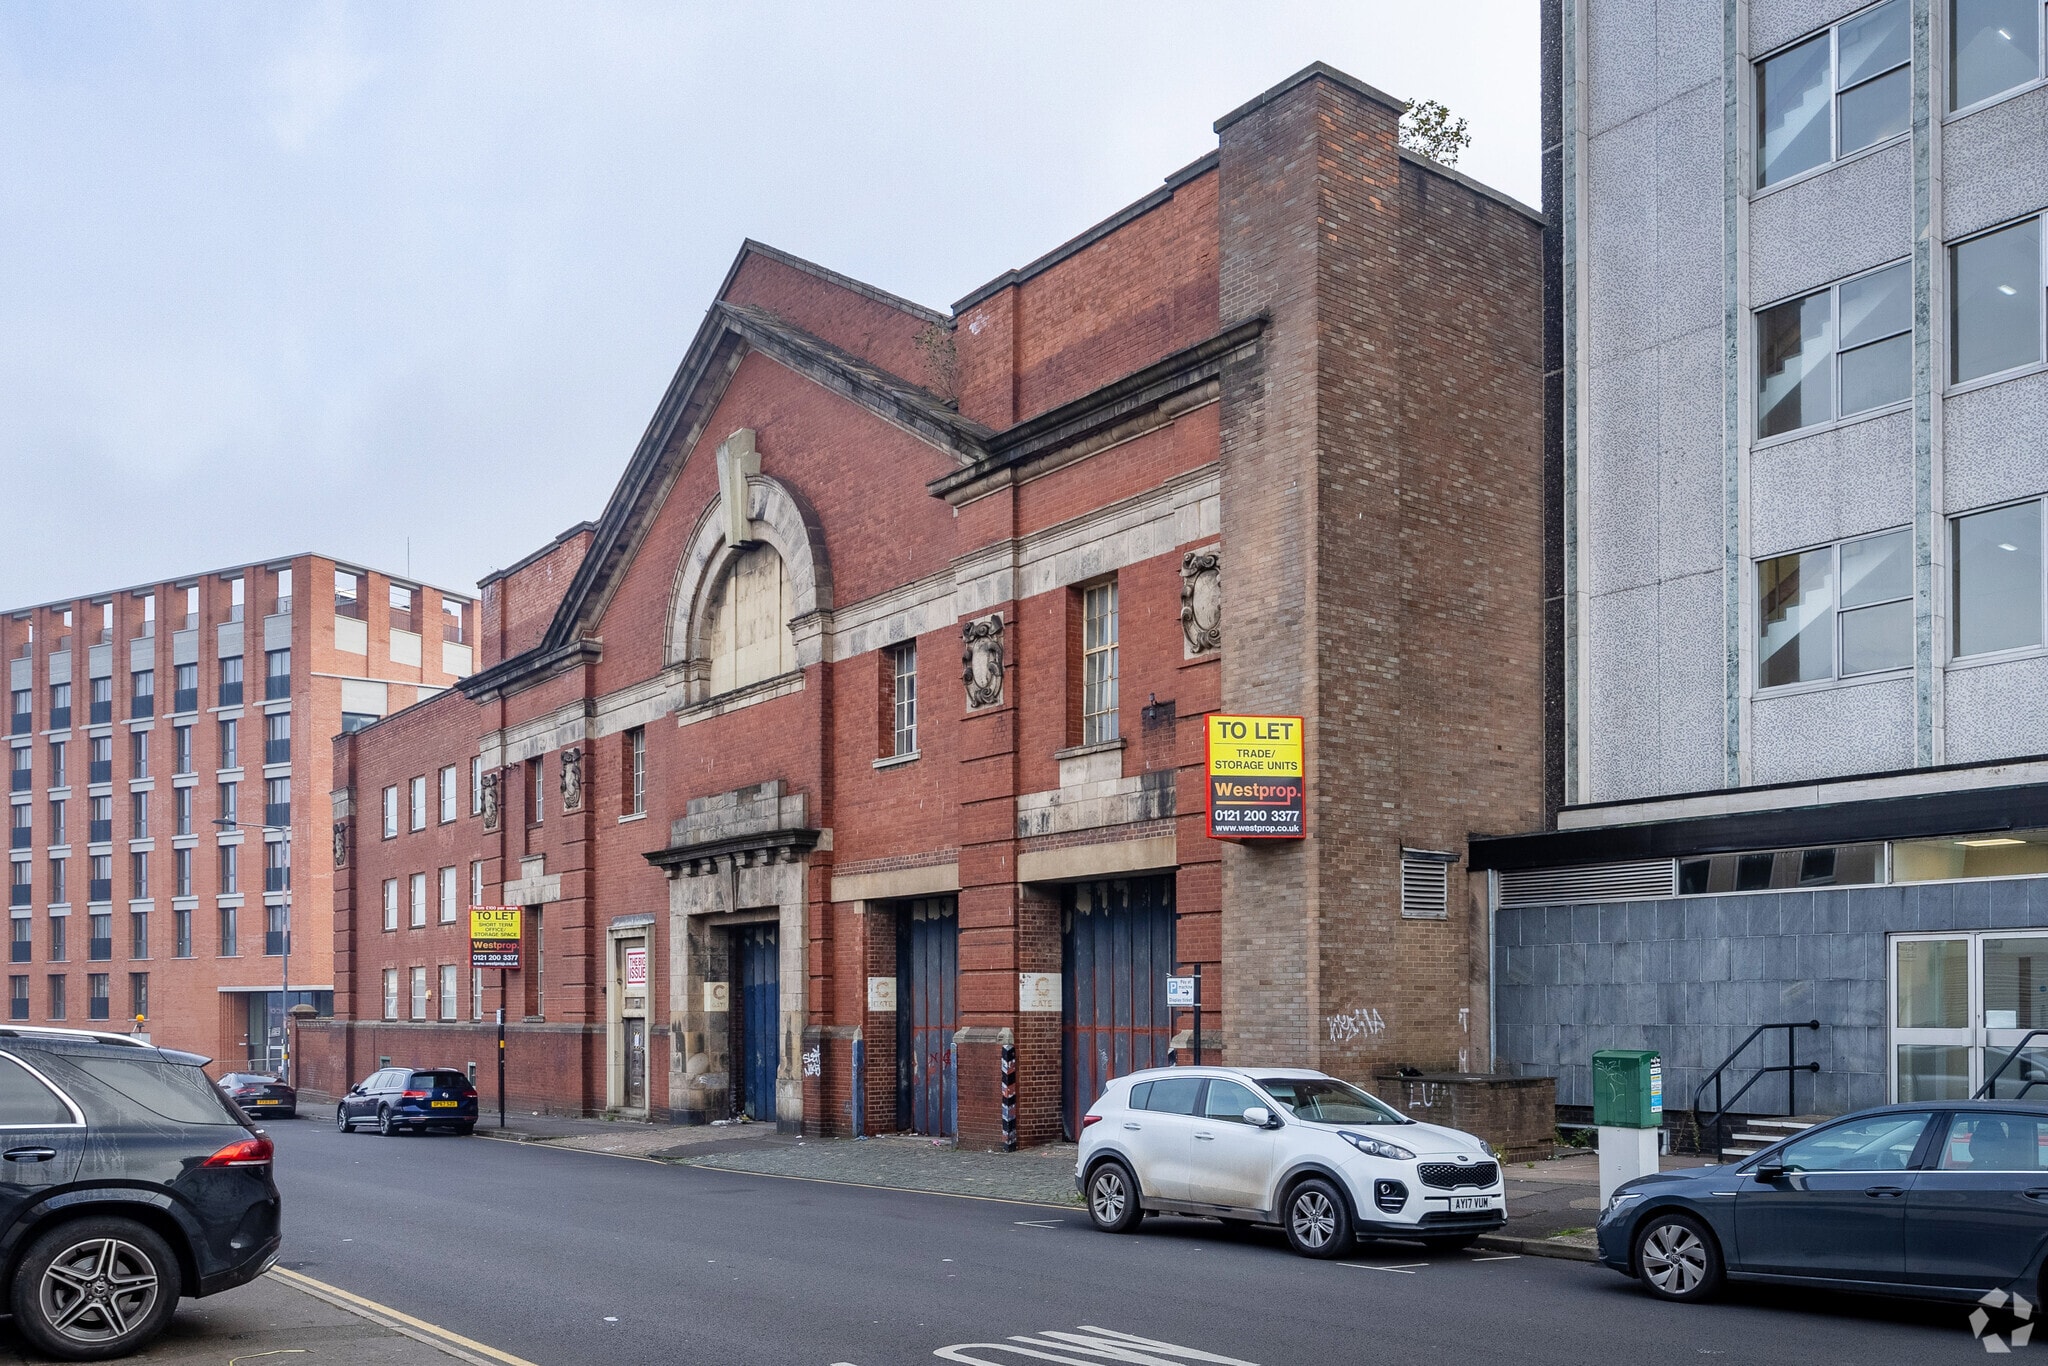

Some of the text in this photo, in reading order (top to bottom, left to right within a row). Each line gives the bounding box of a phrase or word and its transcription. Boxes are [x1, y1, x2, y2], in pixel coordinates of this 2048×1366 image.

[1218, 722, 1293, 740] TO LET
[1236, 749, 1276, 759] TRADE/
[1215, 760, 1298, 770] STORAGE UNITS
[1215, 810, 1299, 821] 0121 200 3377
[1215, 824, 1299, 833] www.westprop.co.uk
[476, 912, 515, 920] TO LET
[1455, 1197, 1489, 1209] AY17 VUM
